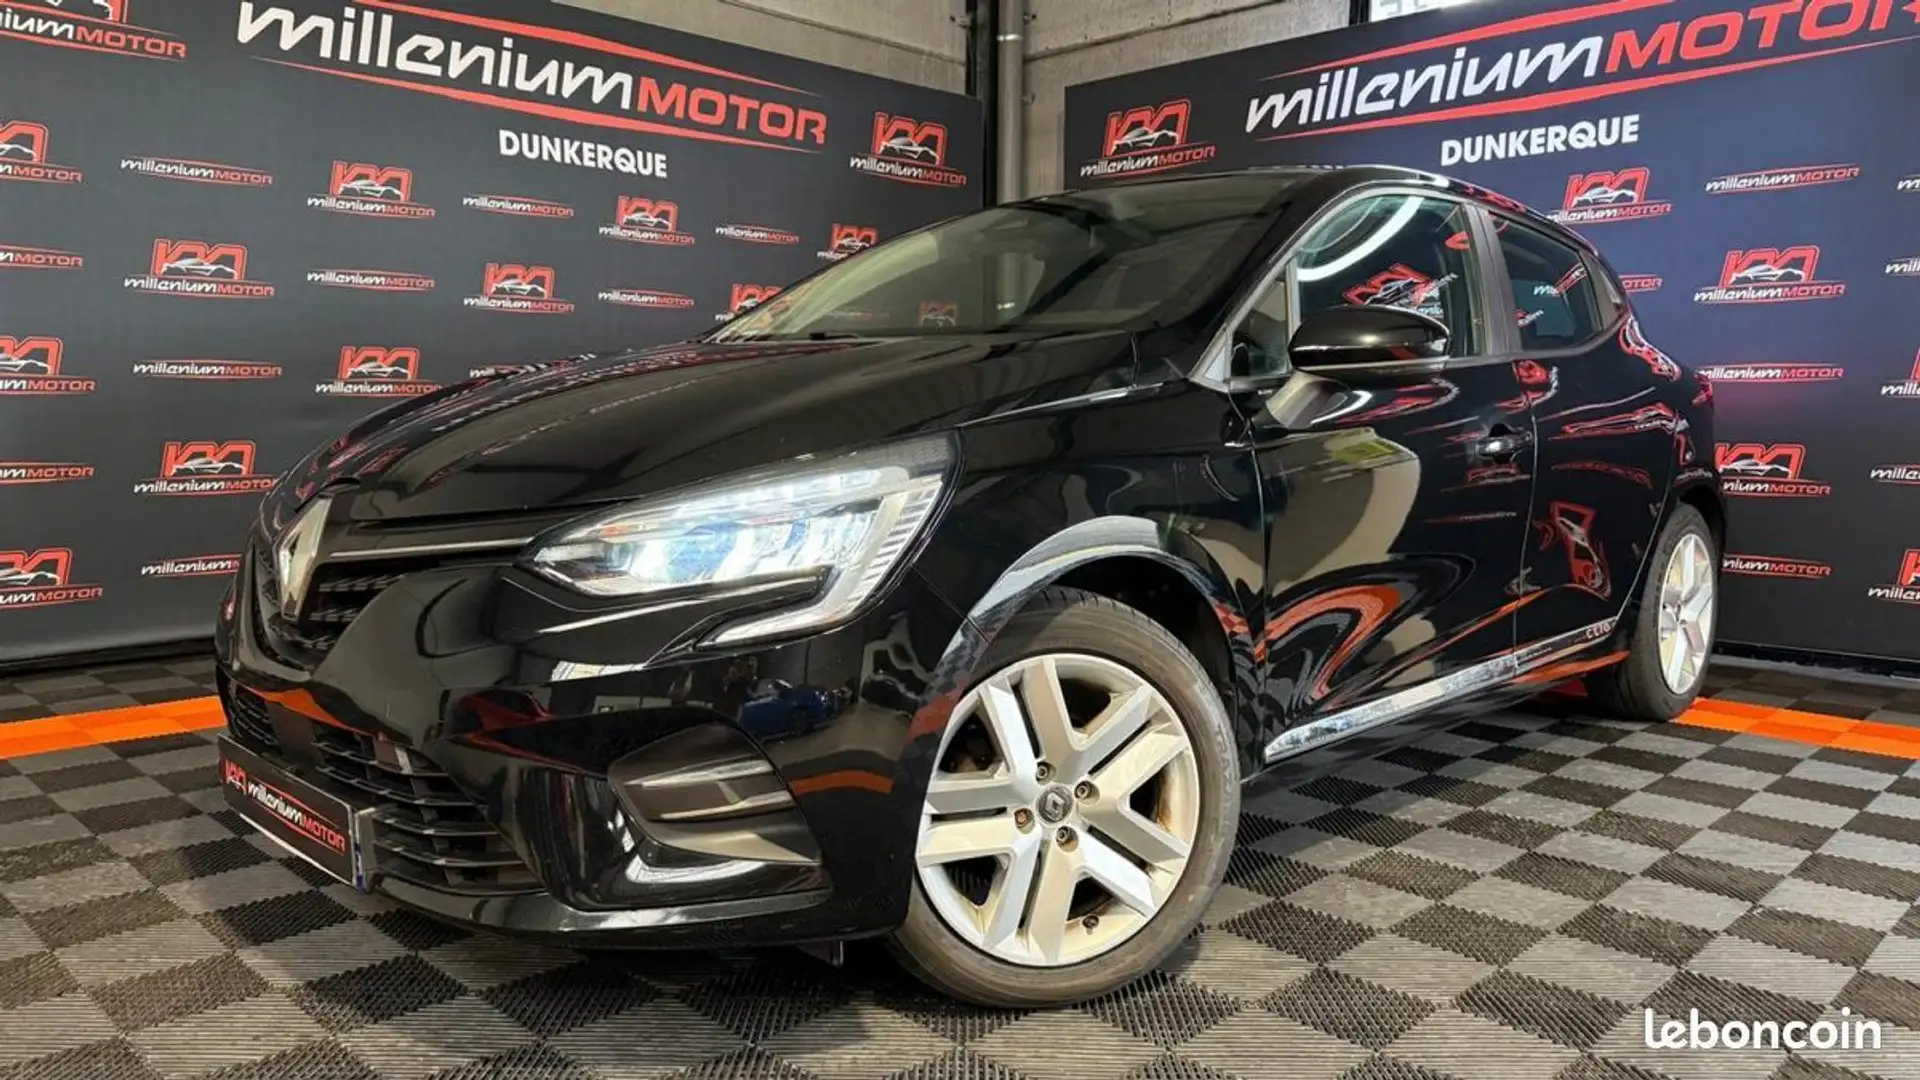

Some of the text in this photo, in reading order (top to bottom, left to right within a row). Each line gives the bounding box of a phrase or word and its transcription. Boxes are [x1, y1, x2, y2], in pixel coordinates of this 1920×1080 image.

[237, 0, 827, 144] milleniumMOTOR
[500, 129, 667, 178] DUNKERQUE
[1441, 114, 1640, 166] DUNKERQUE
[141, 560, 239, 575] millenium
